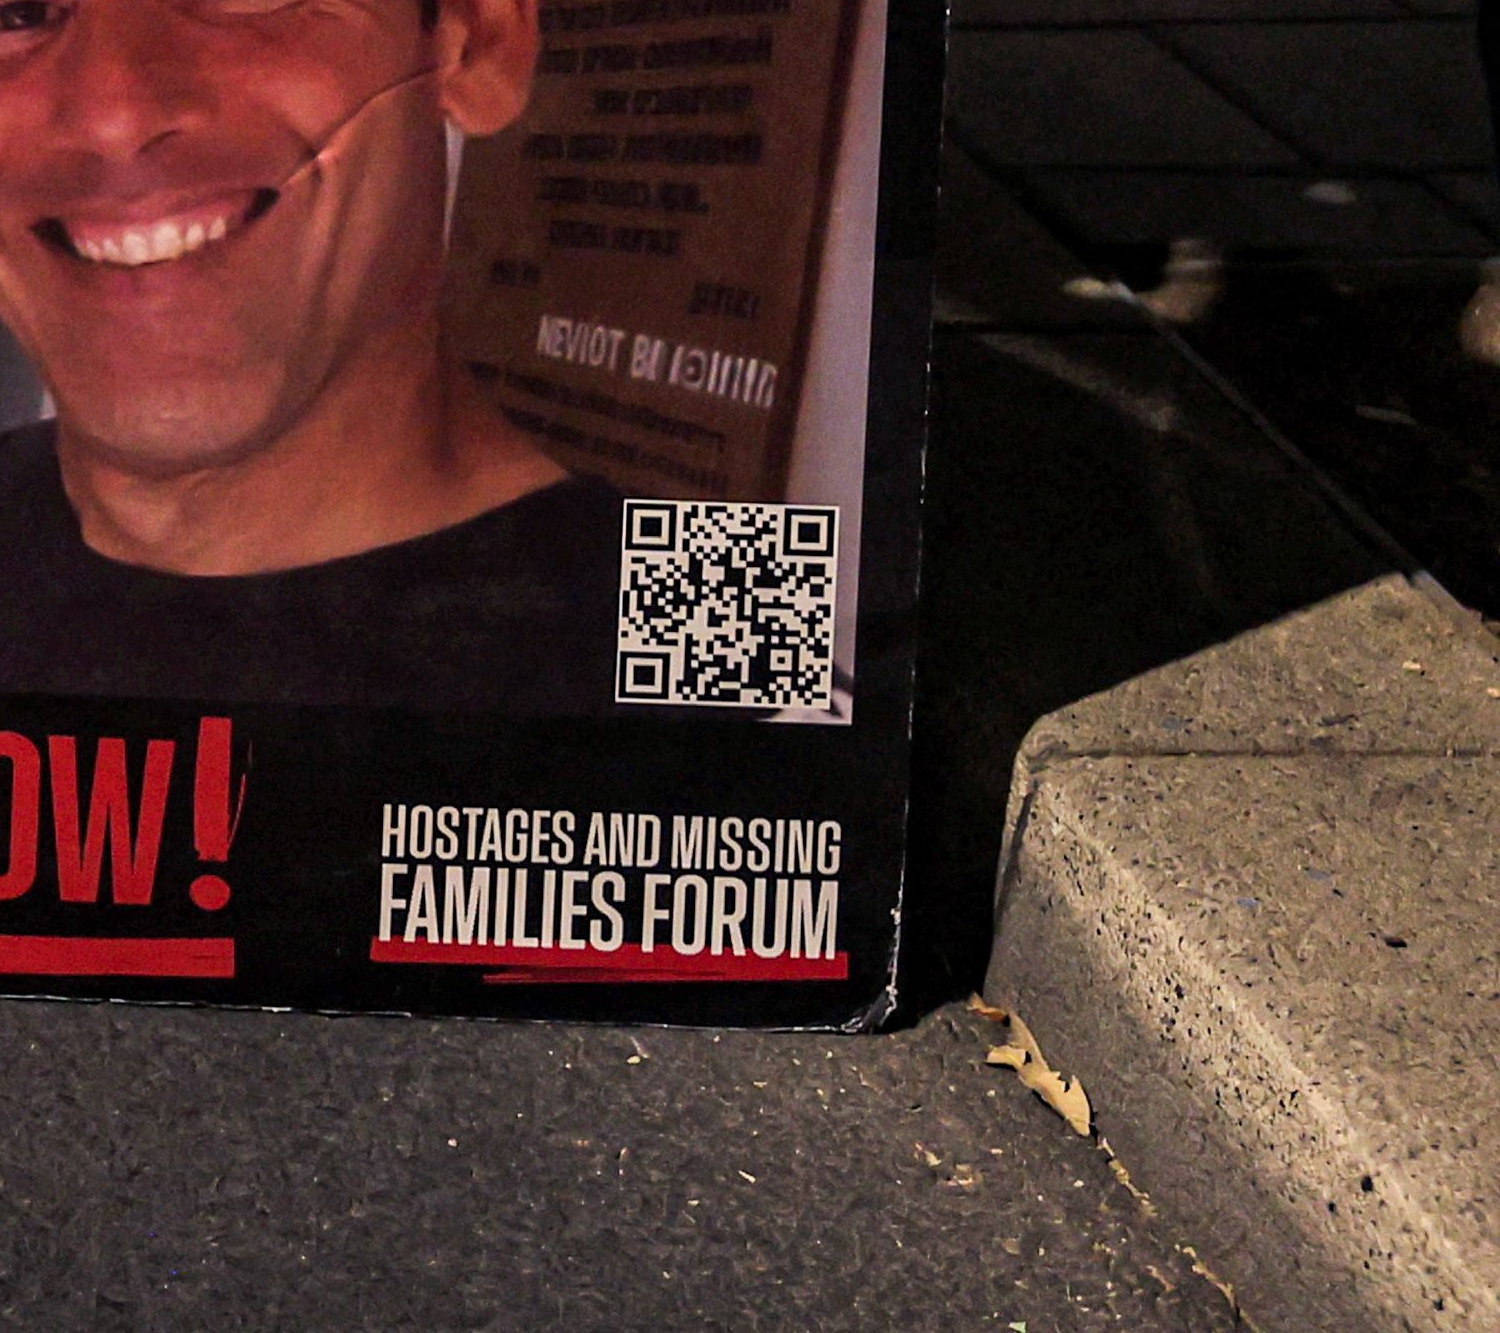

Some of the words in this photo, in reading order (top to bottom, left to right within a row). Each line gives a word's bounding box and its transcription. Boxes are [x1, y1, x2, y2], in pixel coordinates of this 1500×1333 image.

[381, 802, 575, 866] HOSTAGES
[583, 811, 662, 869] AND
[671, 815, 842, 875] MISSING
[377, 861, 625, 952] FAMILIES
[641, 873, 840, 961] FORUM
